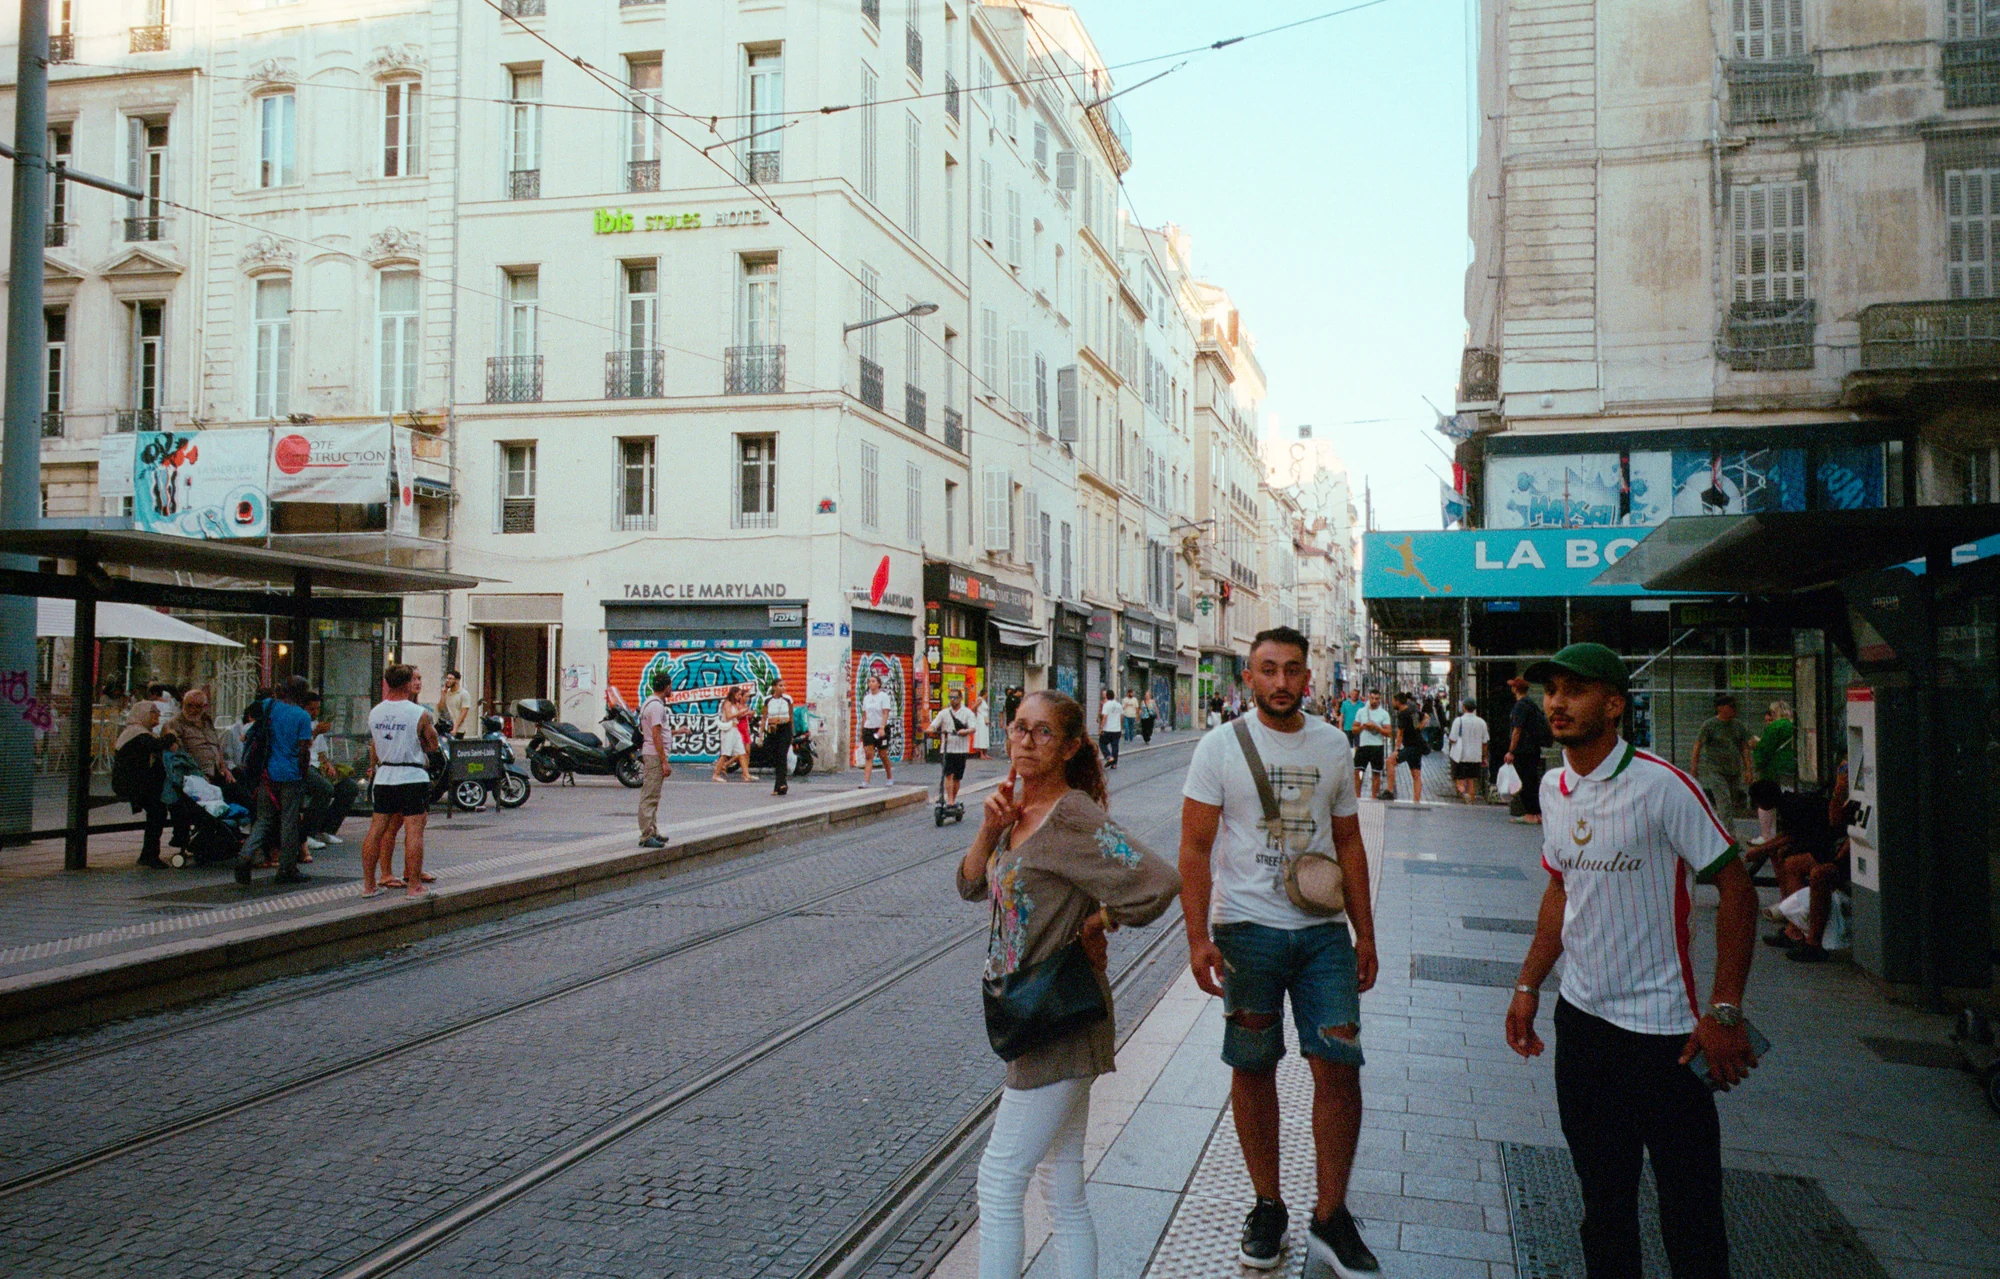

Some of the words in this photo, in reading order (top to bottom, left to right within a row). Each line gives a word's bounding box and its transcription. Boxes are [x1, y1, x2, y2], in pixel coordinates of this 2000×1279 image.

[593, 208, 635, 234] ibis
[715, 208, 769, 227] HOTEL
[1474, 539, 1546, 570] LA
[1565, 538, 1640, 569] BO
[624, 584, 674, 598] TABAC
[680, 584, 694, 598] LE
[699, 583, 786, 598] MARYLAND
[374, 723, 407, 731] ATHLETE
